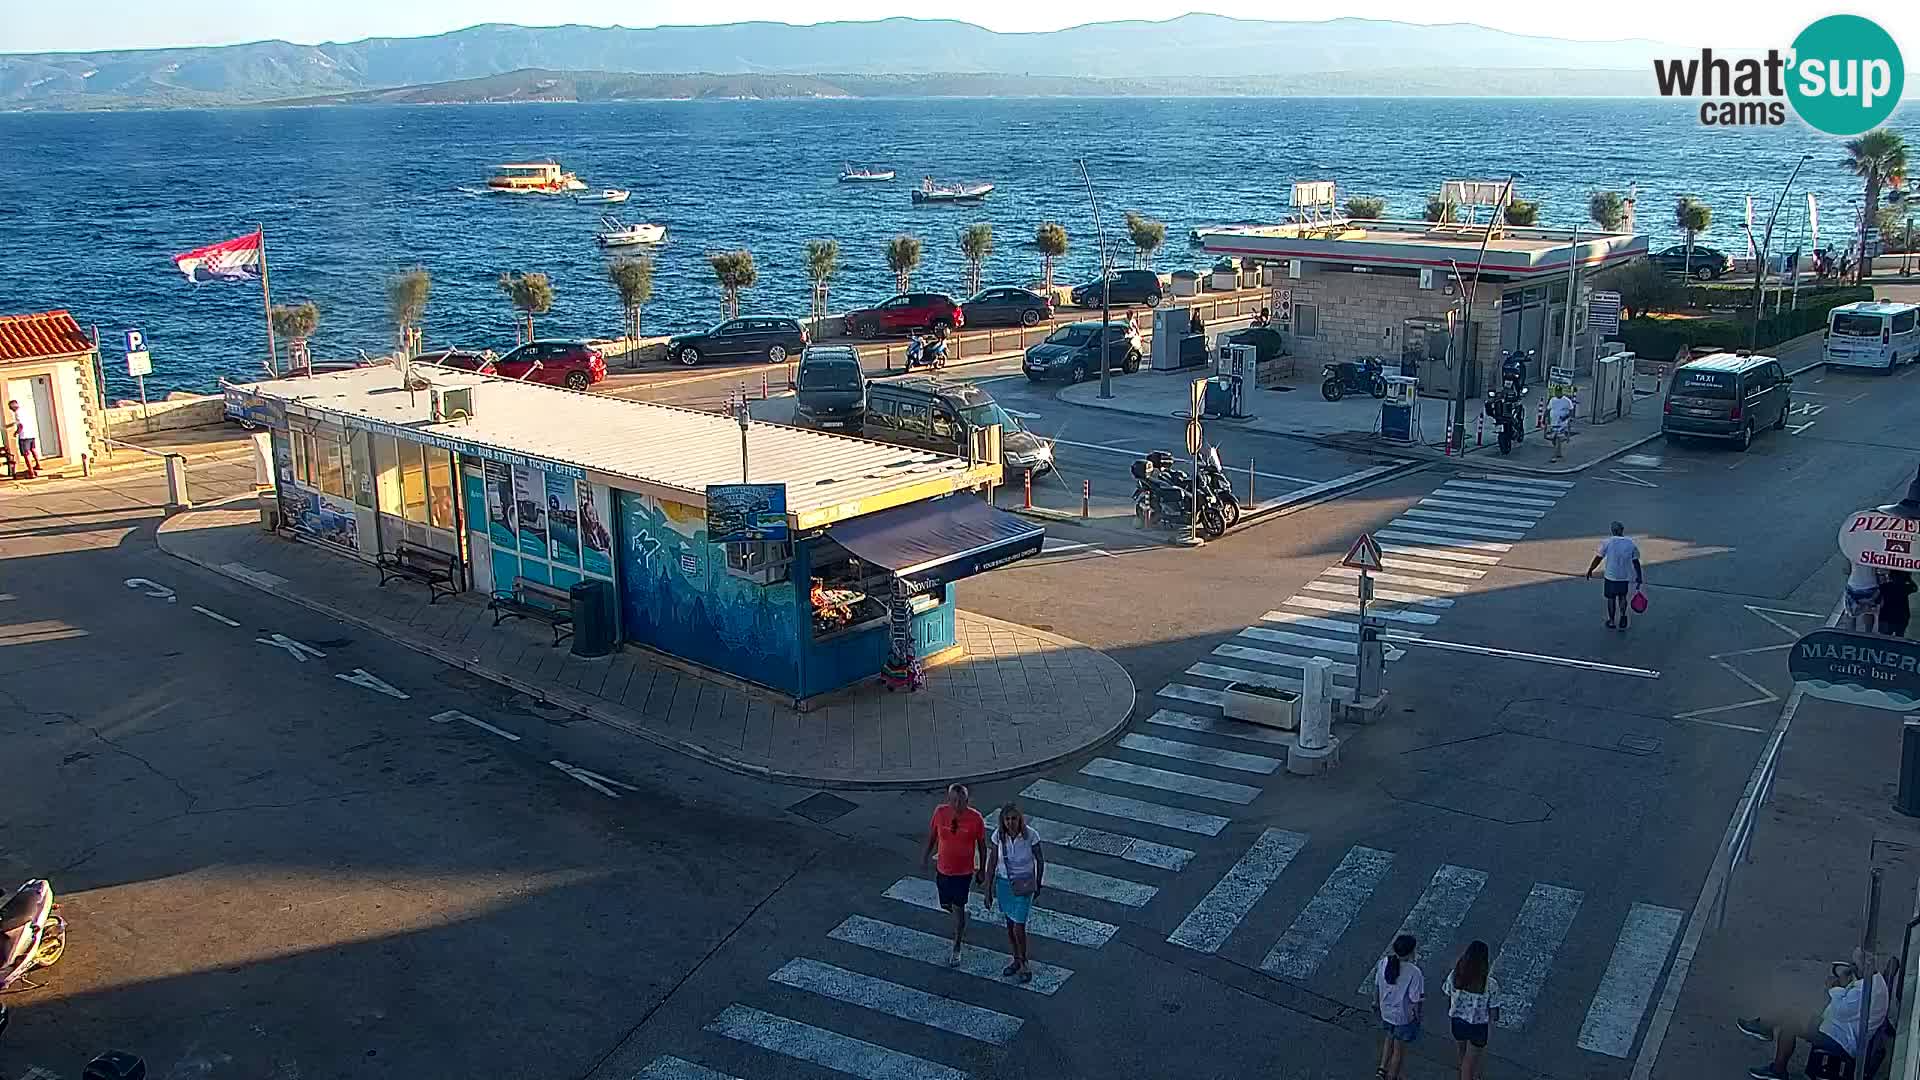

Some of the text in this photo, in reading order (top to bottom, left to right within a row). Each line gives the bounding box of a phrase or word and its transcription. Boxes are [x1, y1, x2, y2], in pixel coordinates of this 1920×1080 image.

[127, 332, 142, 351] P
[1695, 374, 1715, 382] TAXI
[396, 430, 435, 446] AUTOBUSNA
[436, 439, 467, 452] POSTAJA
[478, 447, 492, 459] BUS
[494, 451, 526, 466] STATION
[527, 459, 554, 472] TICKET
[555, 465, 582, 478] OFFICE
[1830, 664, 1897, 681] caffe bar
